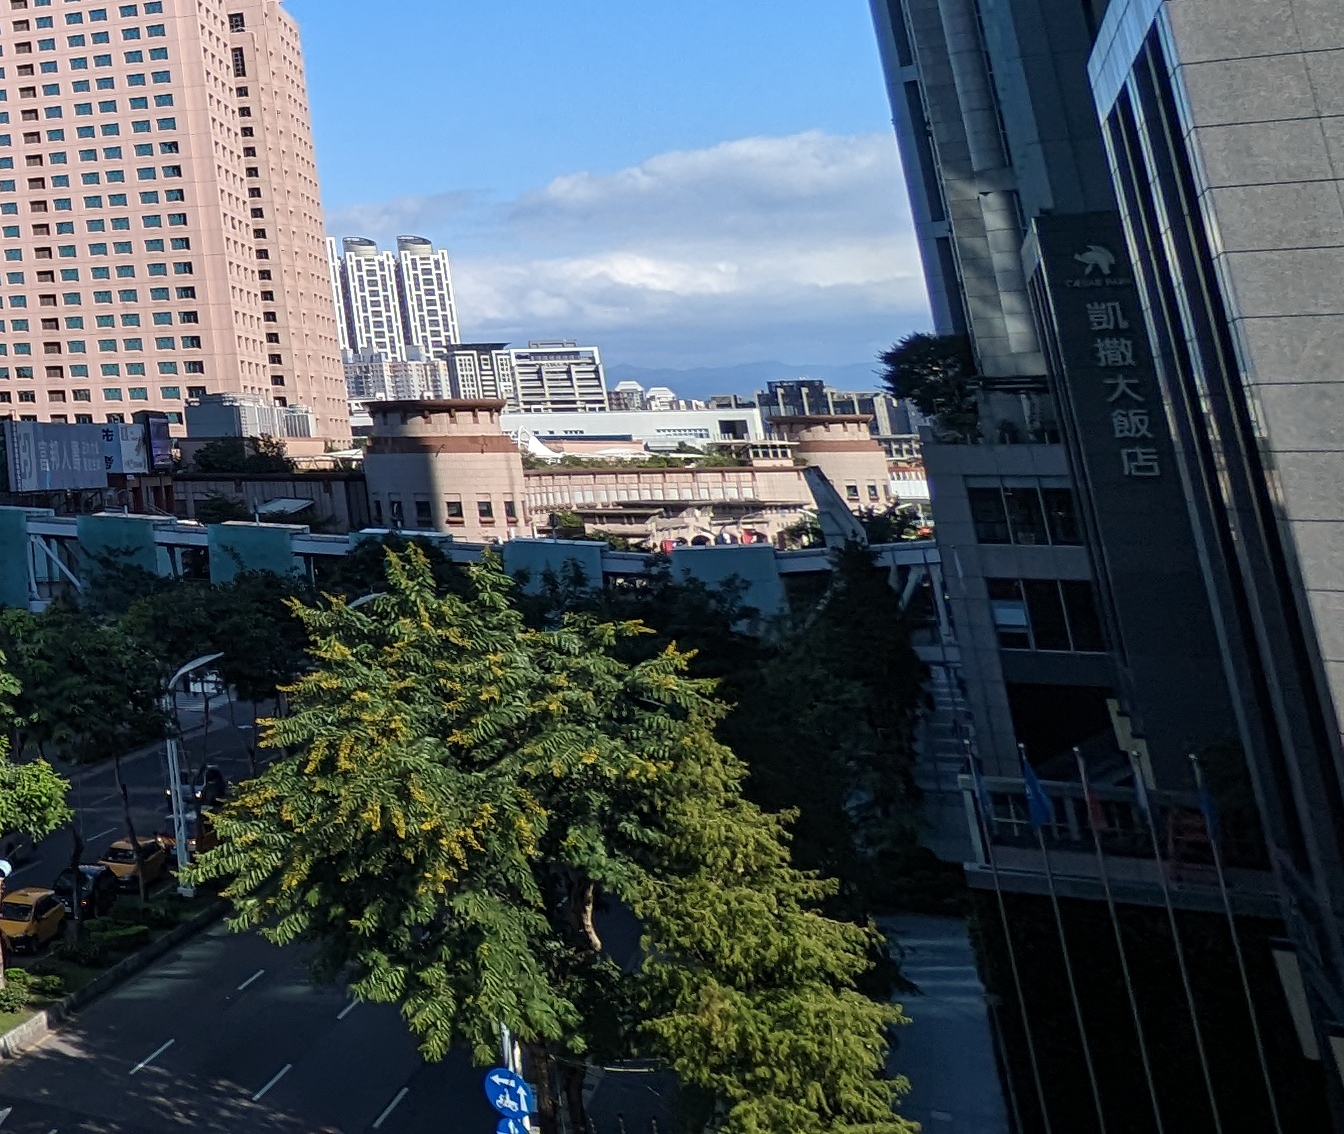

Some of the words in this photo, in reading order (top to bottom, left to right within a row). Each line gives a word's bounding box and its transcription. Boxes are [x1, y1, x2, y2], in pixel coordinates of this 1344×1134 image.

[1086, 301, 1161, 477] 凱撒大飯店
